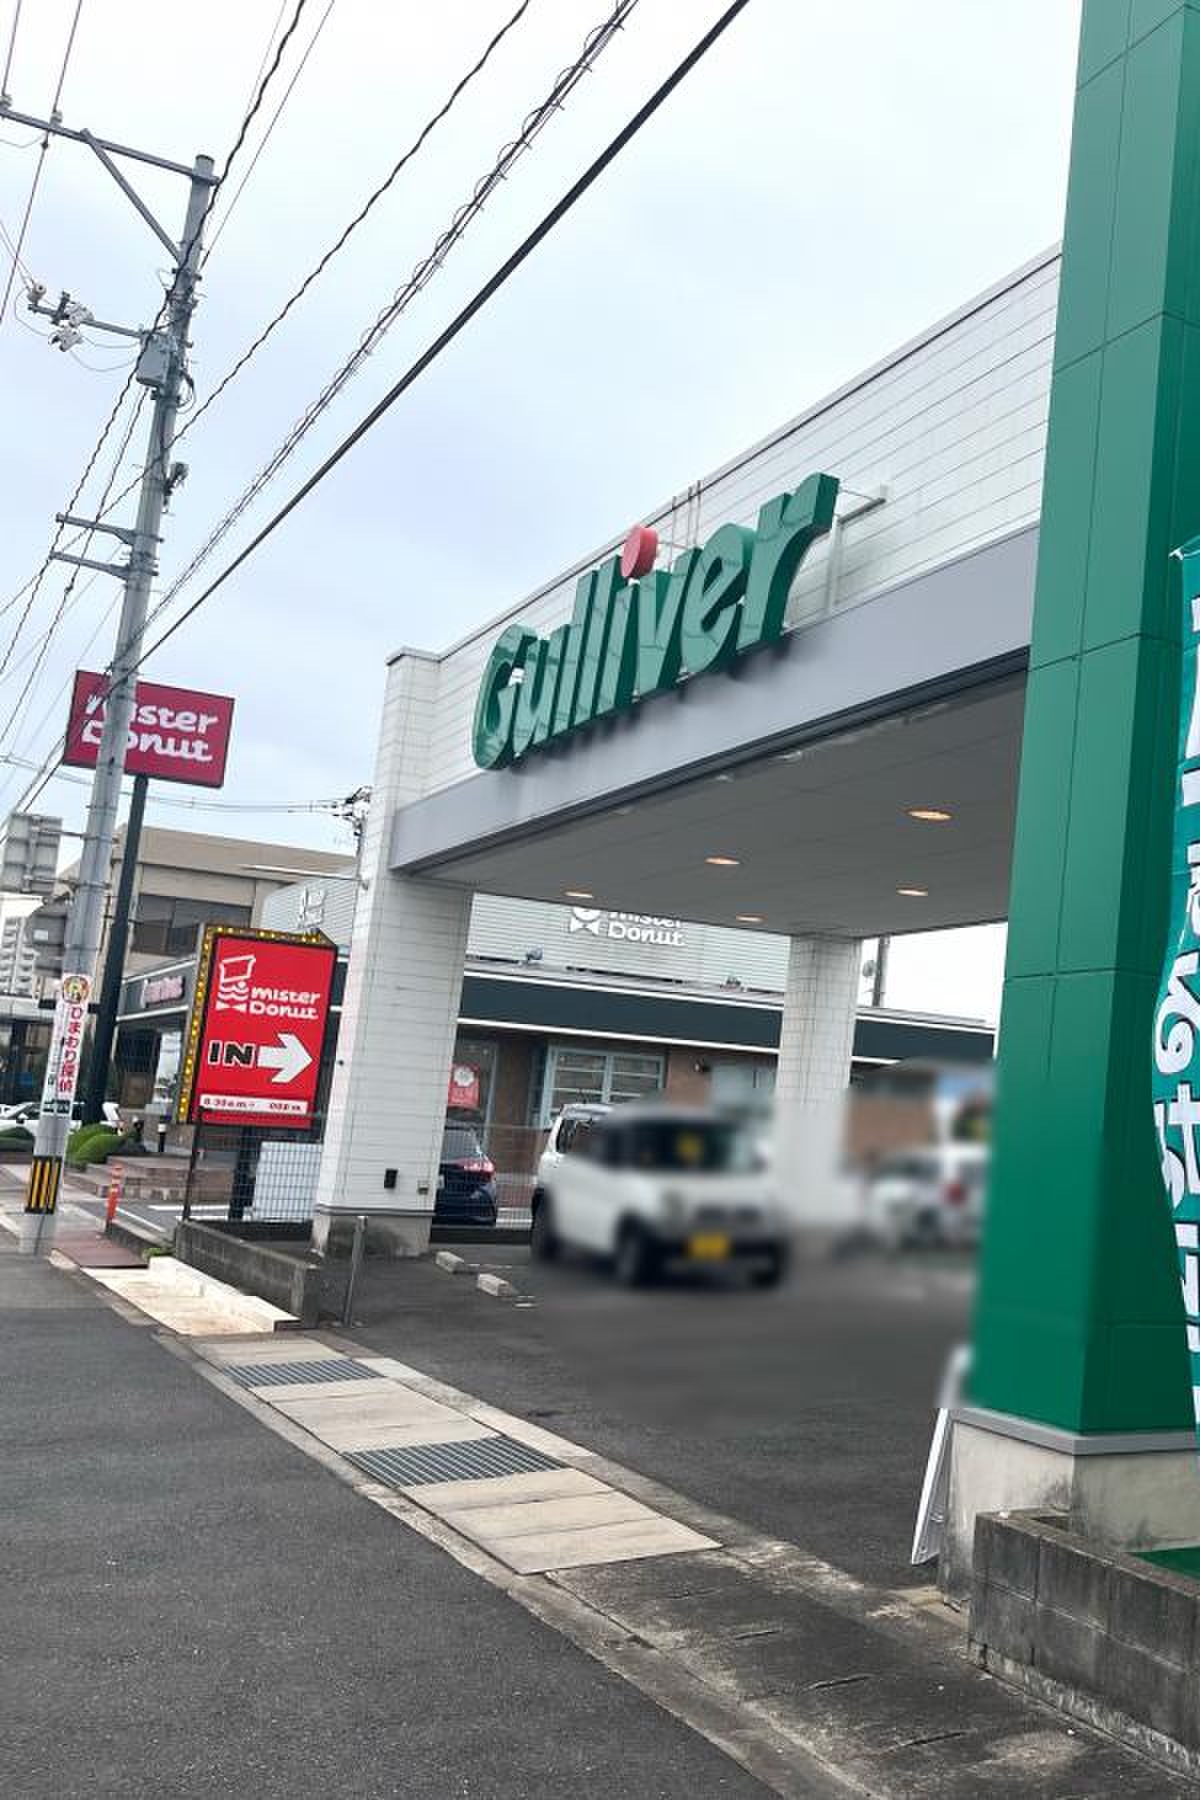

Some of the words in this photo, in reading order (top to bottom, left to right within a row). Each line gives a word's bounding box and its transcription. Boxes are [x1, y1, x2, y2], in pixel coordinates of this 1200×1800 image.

[471, 471, 840, 771] Gulliver
[608, 921, 686, 946] Donut
[251, 985, 321, 1005] mister
[249, 1000, 319, 1020] Donut
[208, 1040, 257, 1069] IN
